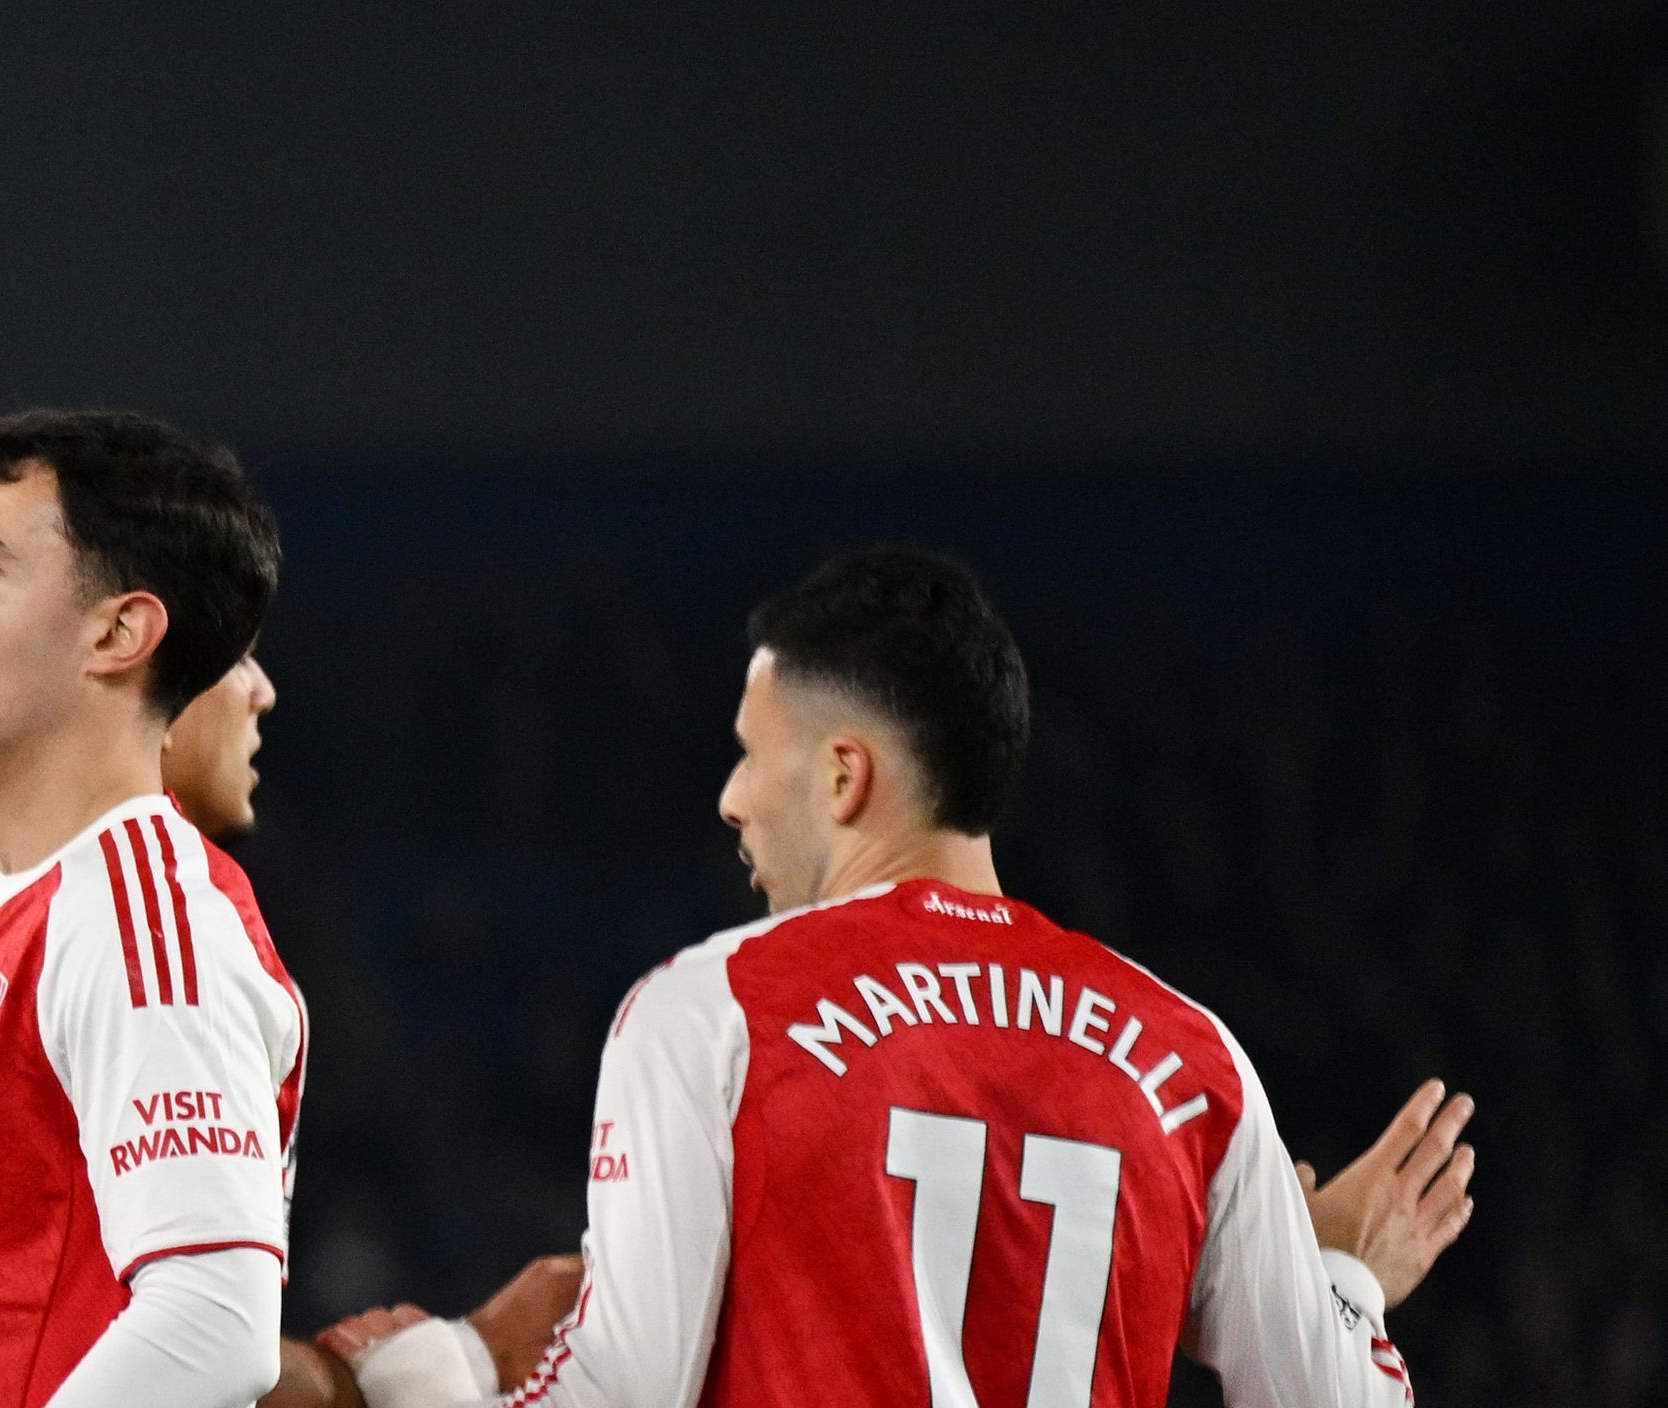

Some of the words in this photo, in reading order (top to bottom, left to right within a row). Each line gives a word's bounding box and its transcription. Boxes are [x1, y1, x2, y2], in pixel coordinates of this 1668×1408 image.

[923, 891, 1013, 925] Arsenal
[786, 963, 1209, 1136] MARTINELLI
[133, 1091, 222, 1126] VISIT
[111, 1126, 266, 1177] RWANDA
